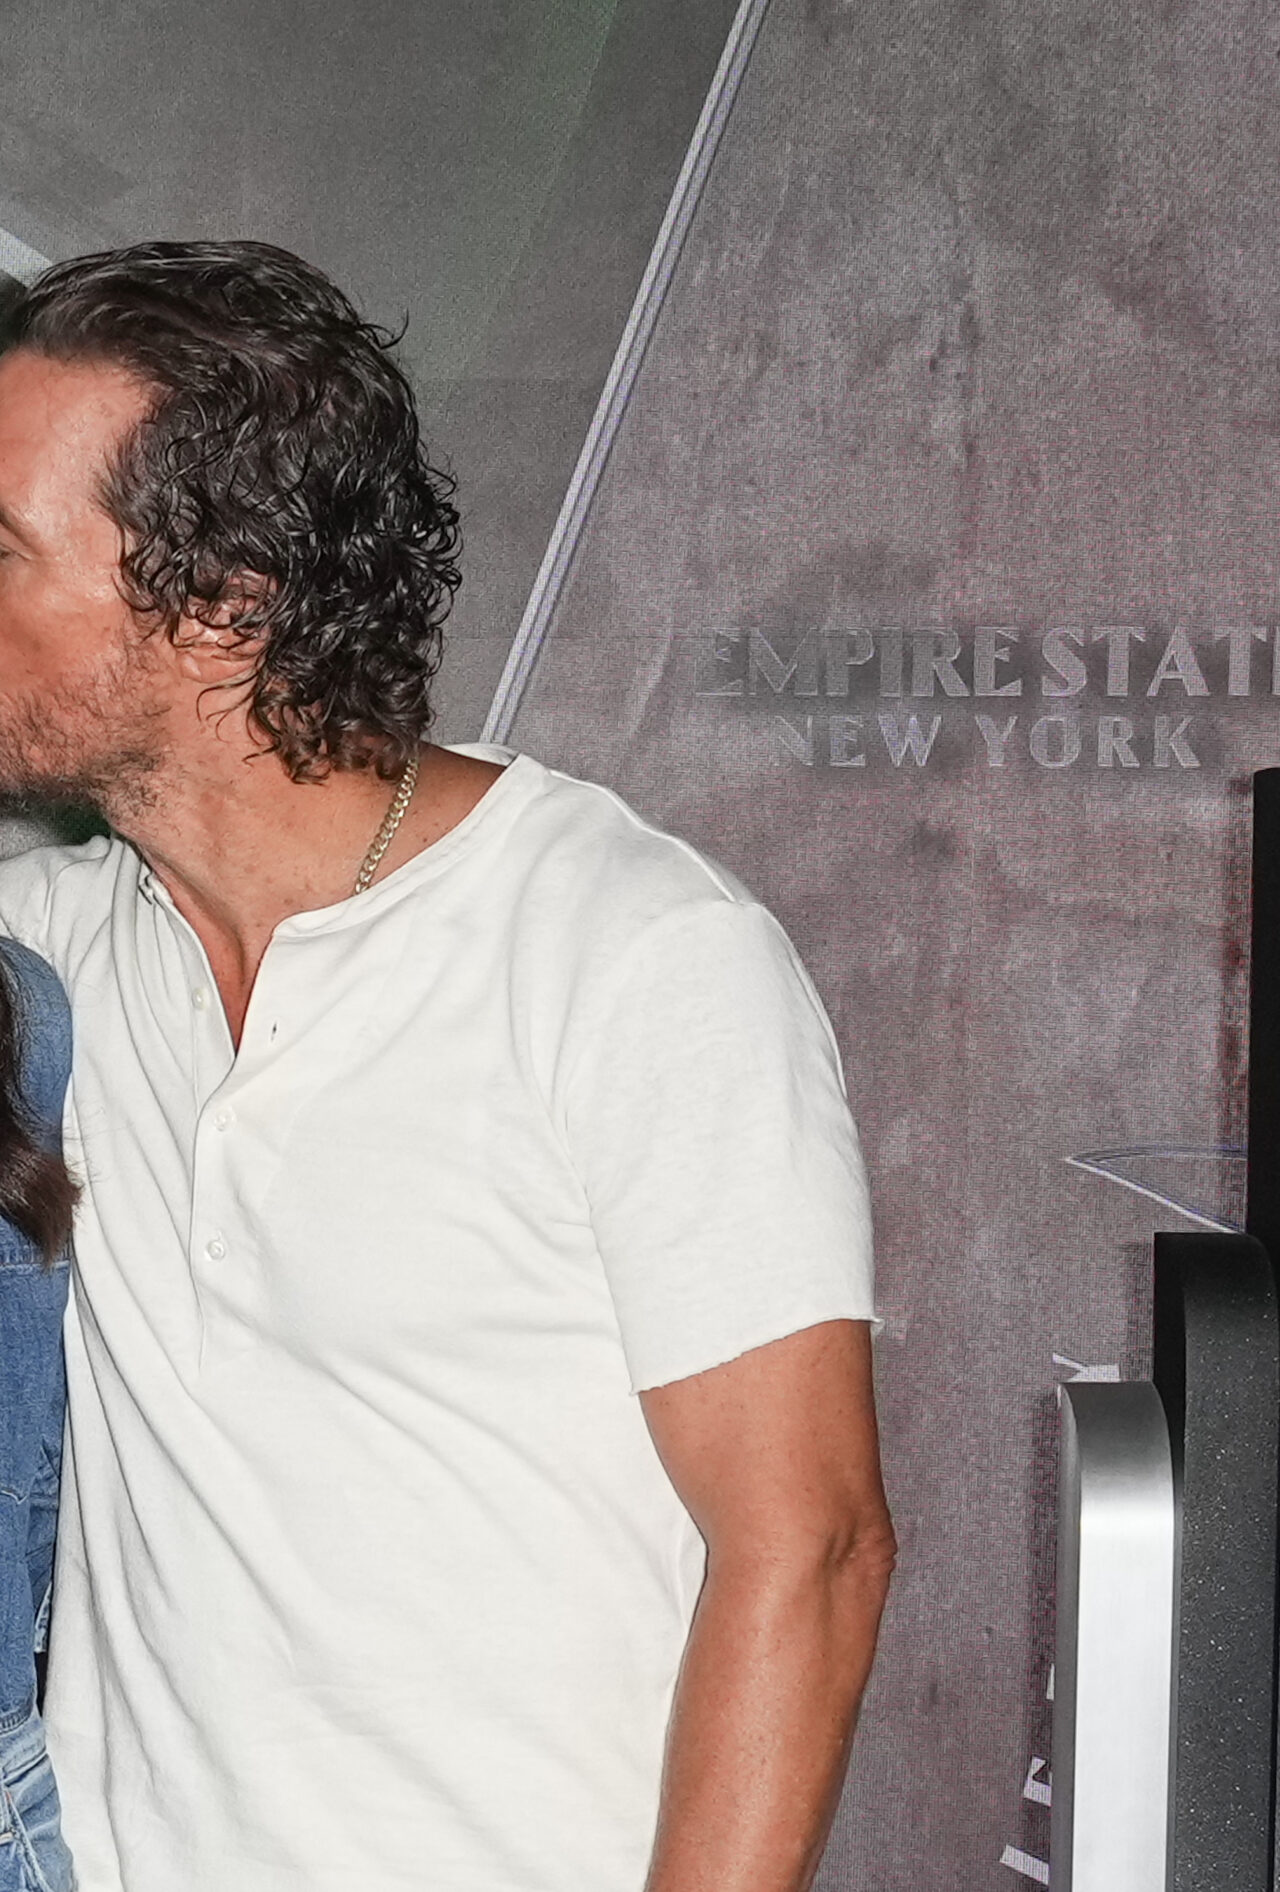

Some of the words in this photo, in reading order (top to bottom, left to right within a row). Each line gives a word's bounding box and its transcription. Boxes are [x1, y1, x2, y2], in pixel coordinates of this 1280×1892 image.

[695, 626, 1022, 697] EMPIRE
[1042, 626, 1280, 697] STAT
[773, 714, 942, 767] NEW
[974, 714, 1201, 769] YORK
